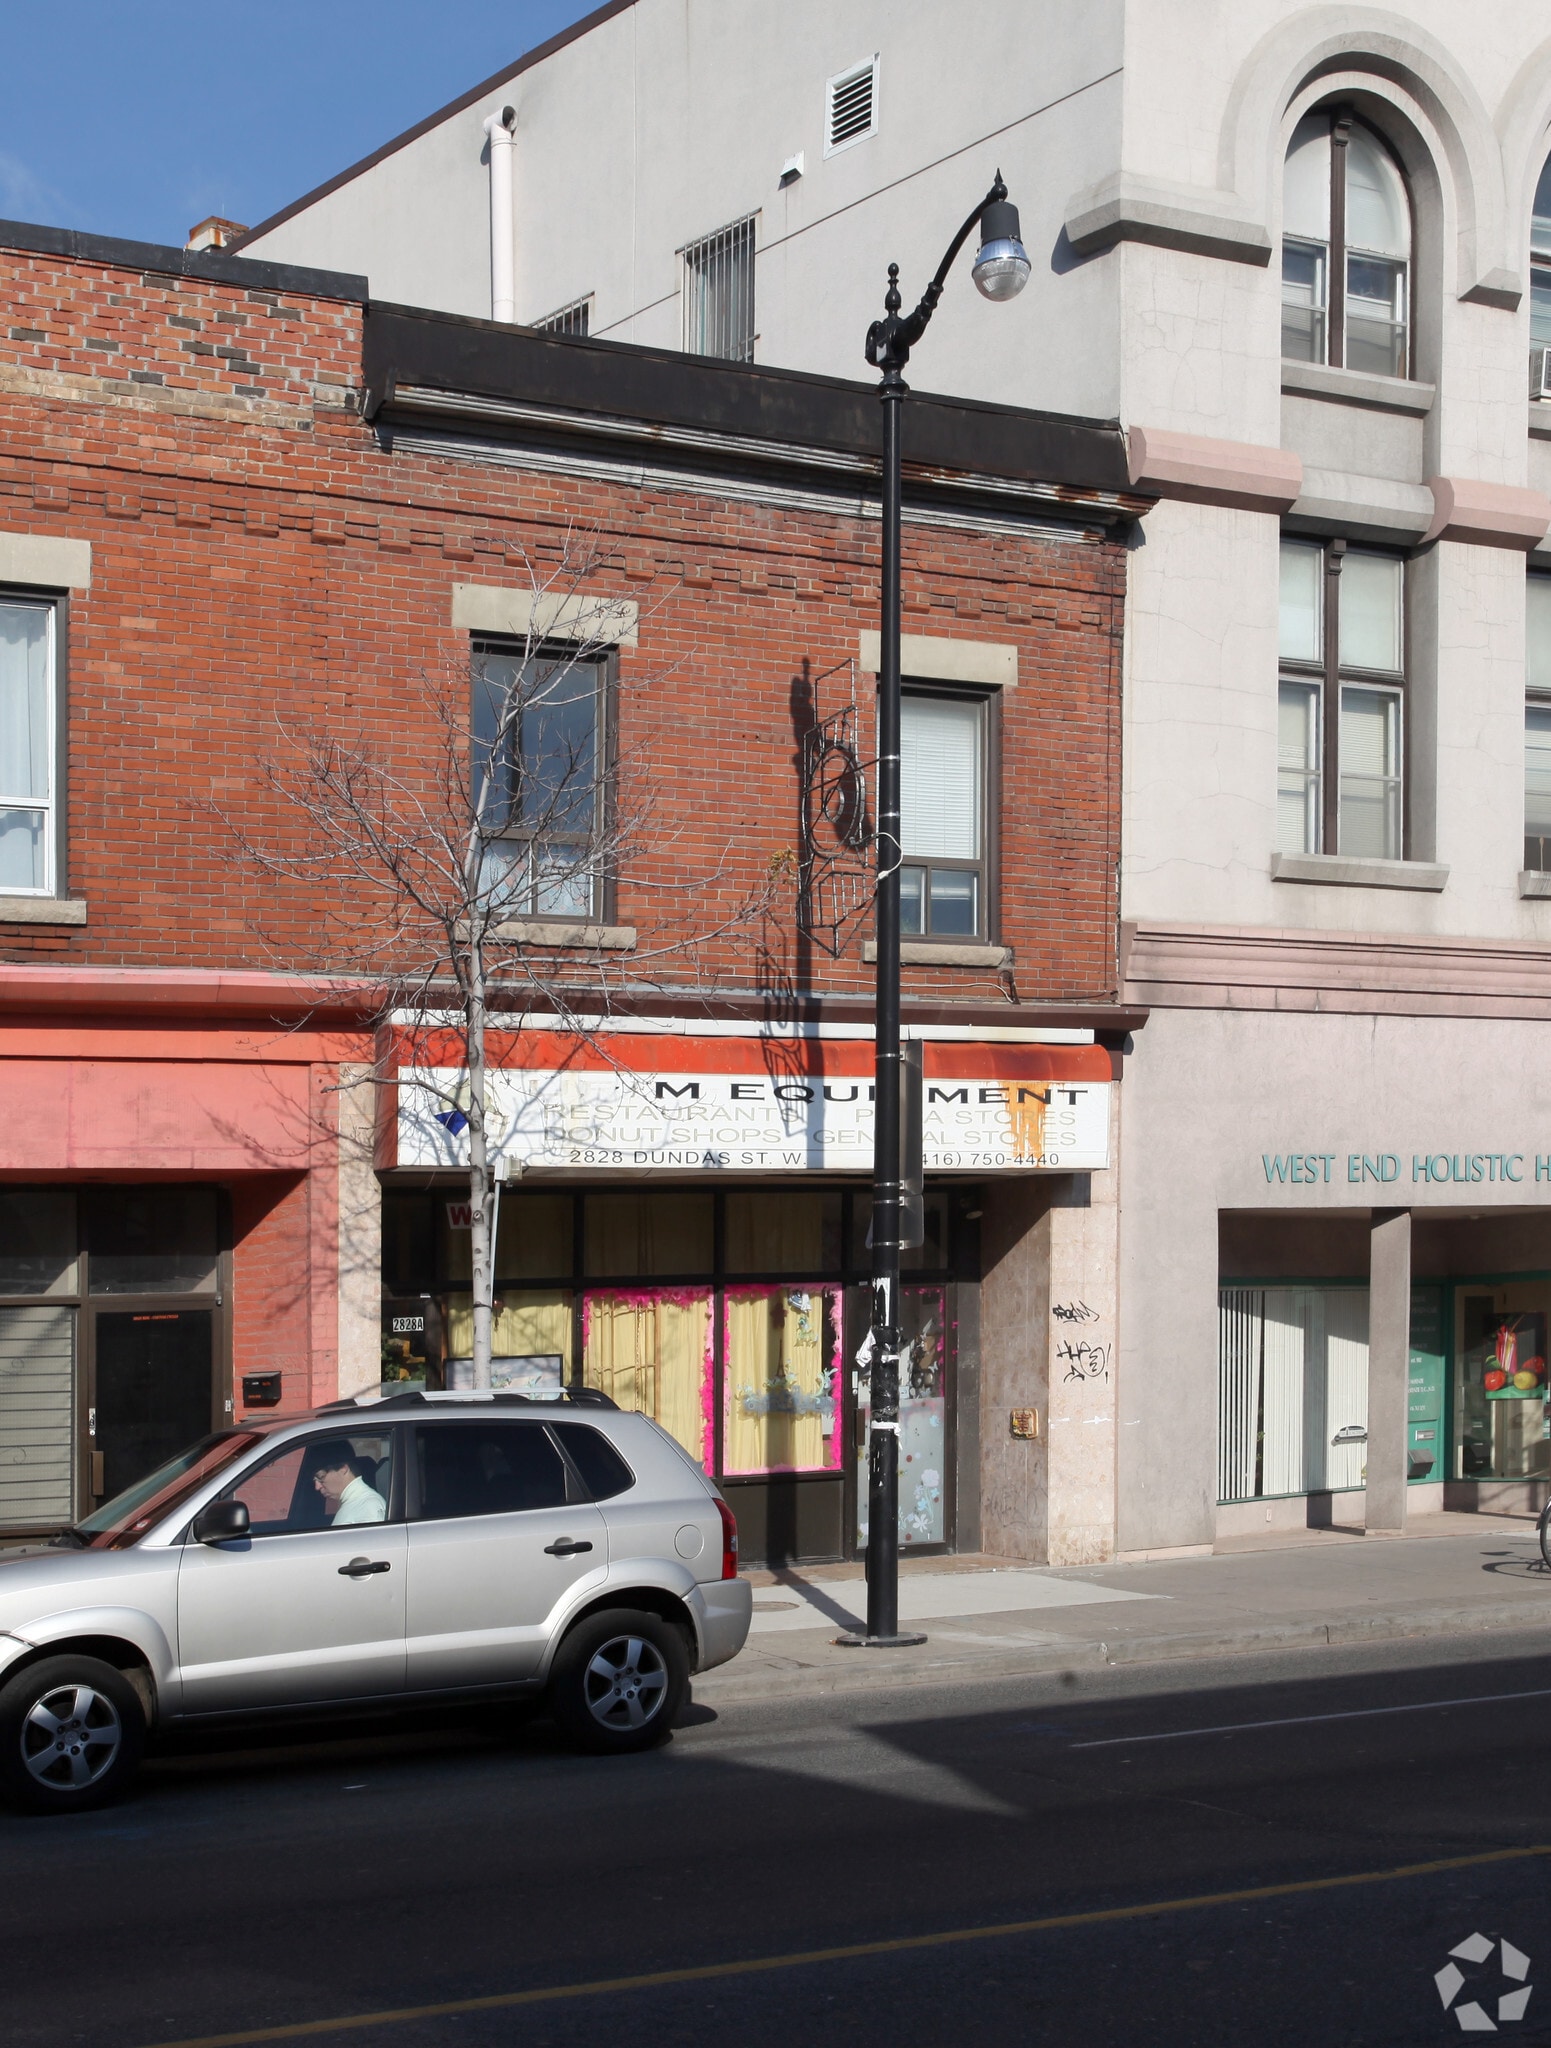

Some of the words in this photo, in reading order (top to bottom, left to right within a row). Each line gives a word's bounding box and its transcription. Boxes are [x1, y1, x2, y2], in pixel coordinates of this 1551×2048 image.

[730, 1083, 1088, 1105] EQUIMENT
[544, 1103, 798, 1123] RESTAURANTS
[544, 1126, 662, 1142] DONUT
[671, 1128, 782, 1143] SHOPS
[812, 1129, 955, 1145] GENAL
[569, 1150, 623, 1164] 2828
[634, 1151, 731, 1165] DUNDAS
[741, 1152, 772, 1165] ST.
[970, 1153, 1059, 1166] 750-4440
[1262, 1154, 1336, 1183] WEST
[1347, 1154, 1401, 1182] END
[1412, 1154, 1524, 1183] HOLISTIC
[394, 1318, 423, 1330] 2828A
